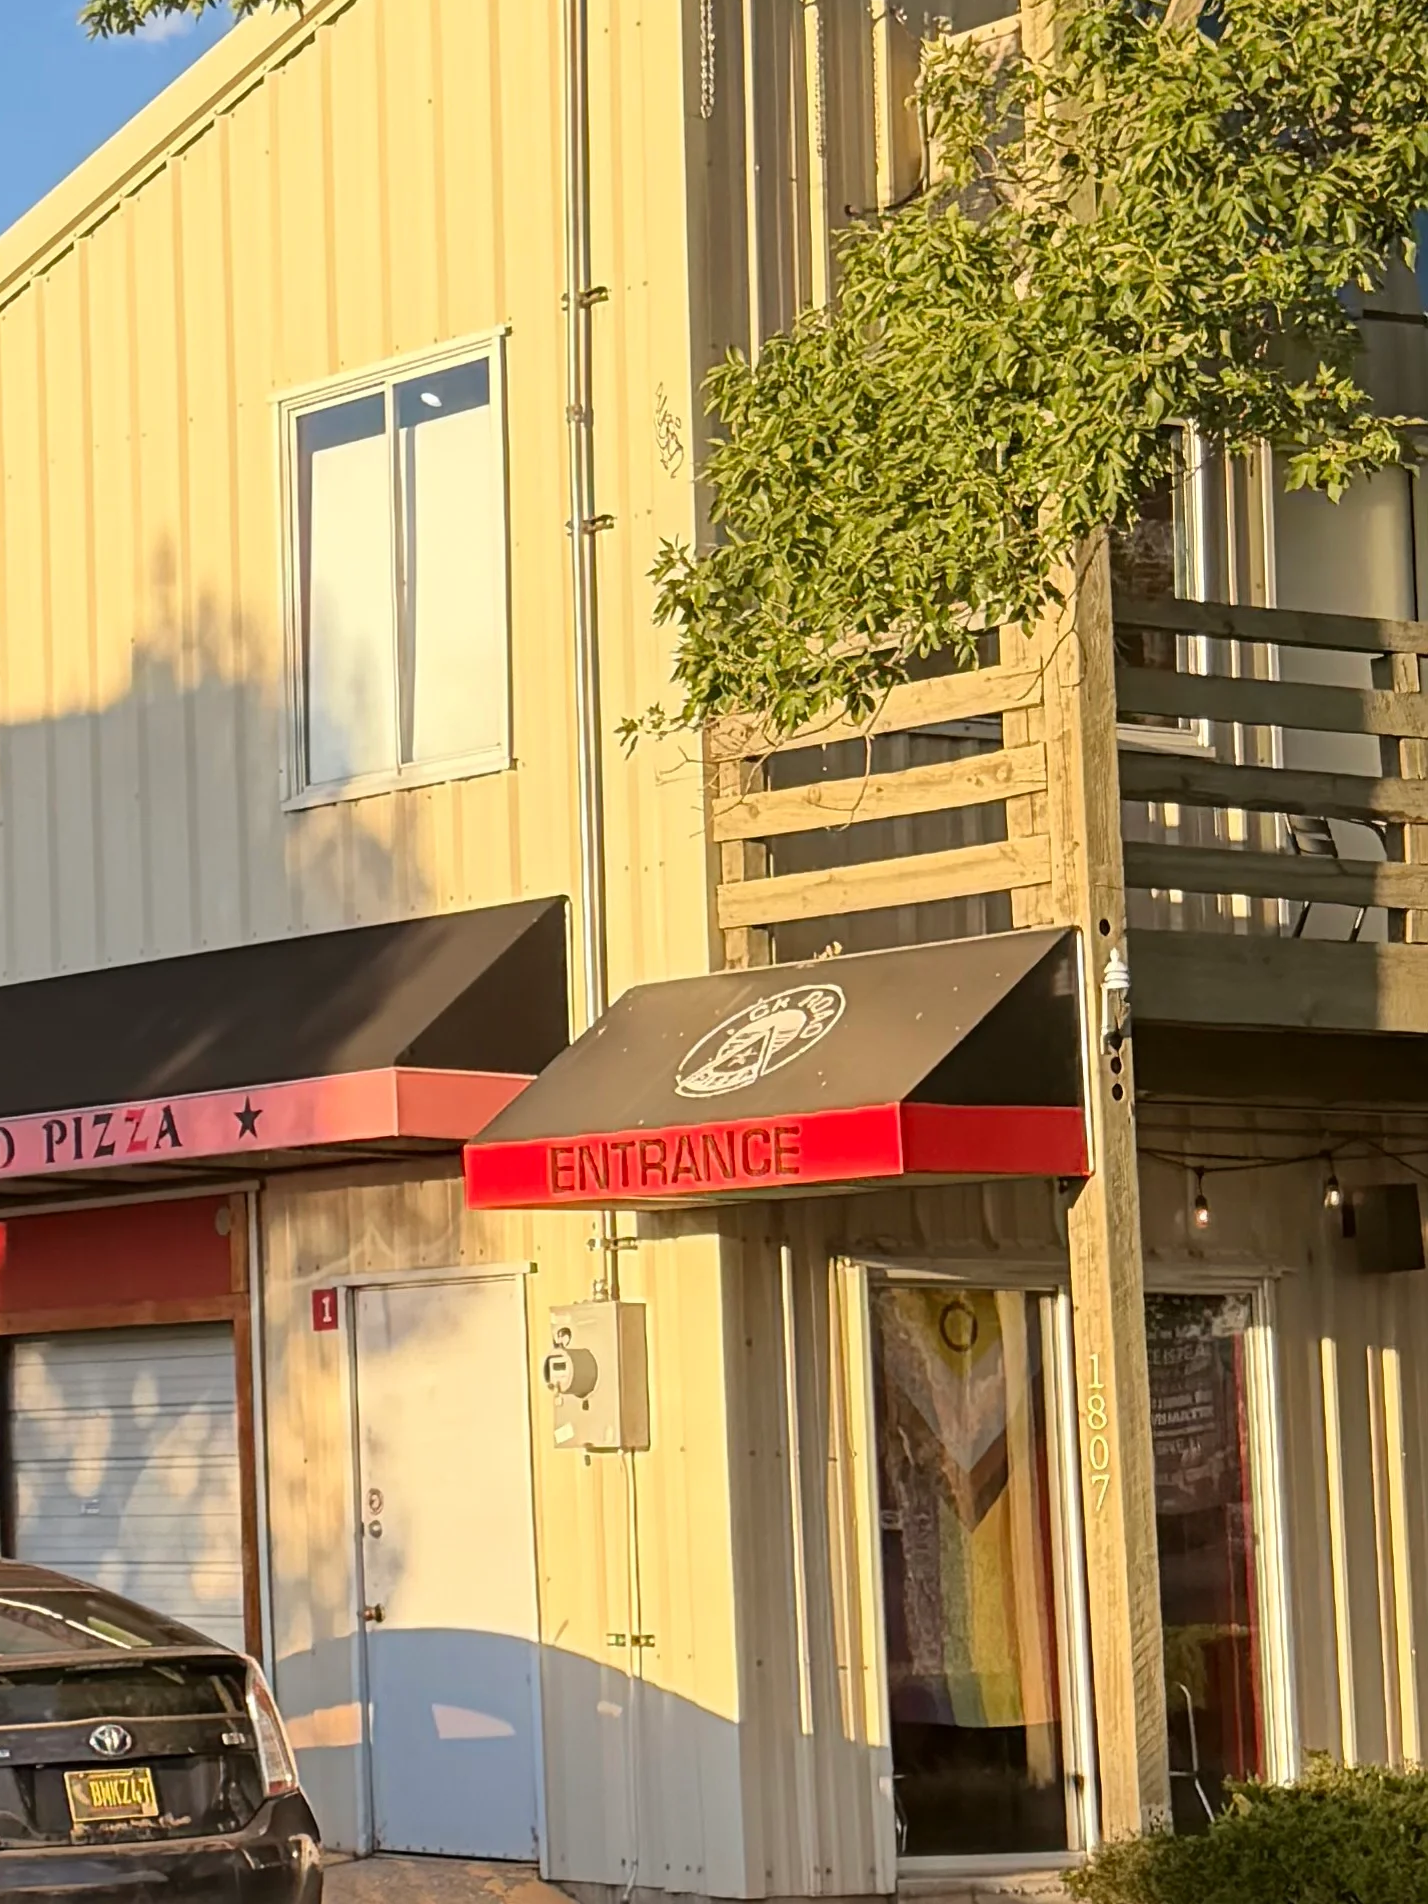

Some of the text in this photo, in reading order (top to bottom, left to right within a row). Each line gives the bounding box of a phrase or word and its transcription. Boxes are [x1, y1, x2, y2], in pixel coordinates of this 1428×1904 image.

[41, 1104, 183, 1164] PIZZA
[550, 1125, 801, 1194] ENTRANCE
[321, 1295, 333, 1323] 1
[1087, 1353, 1111, 1512] 1807
